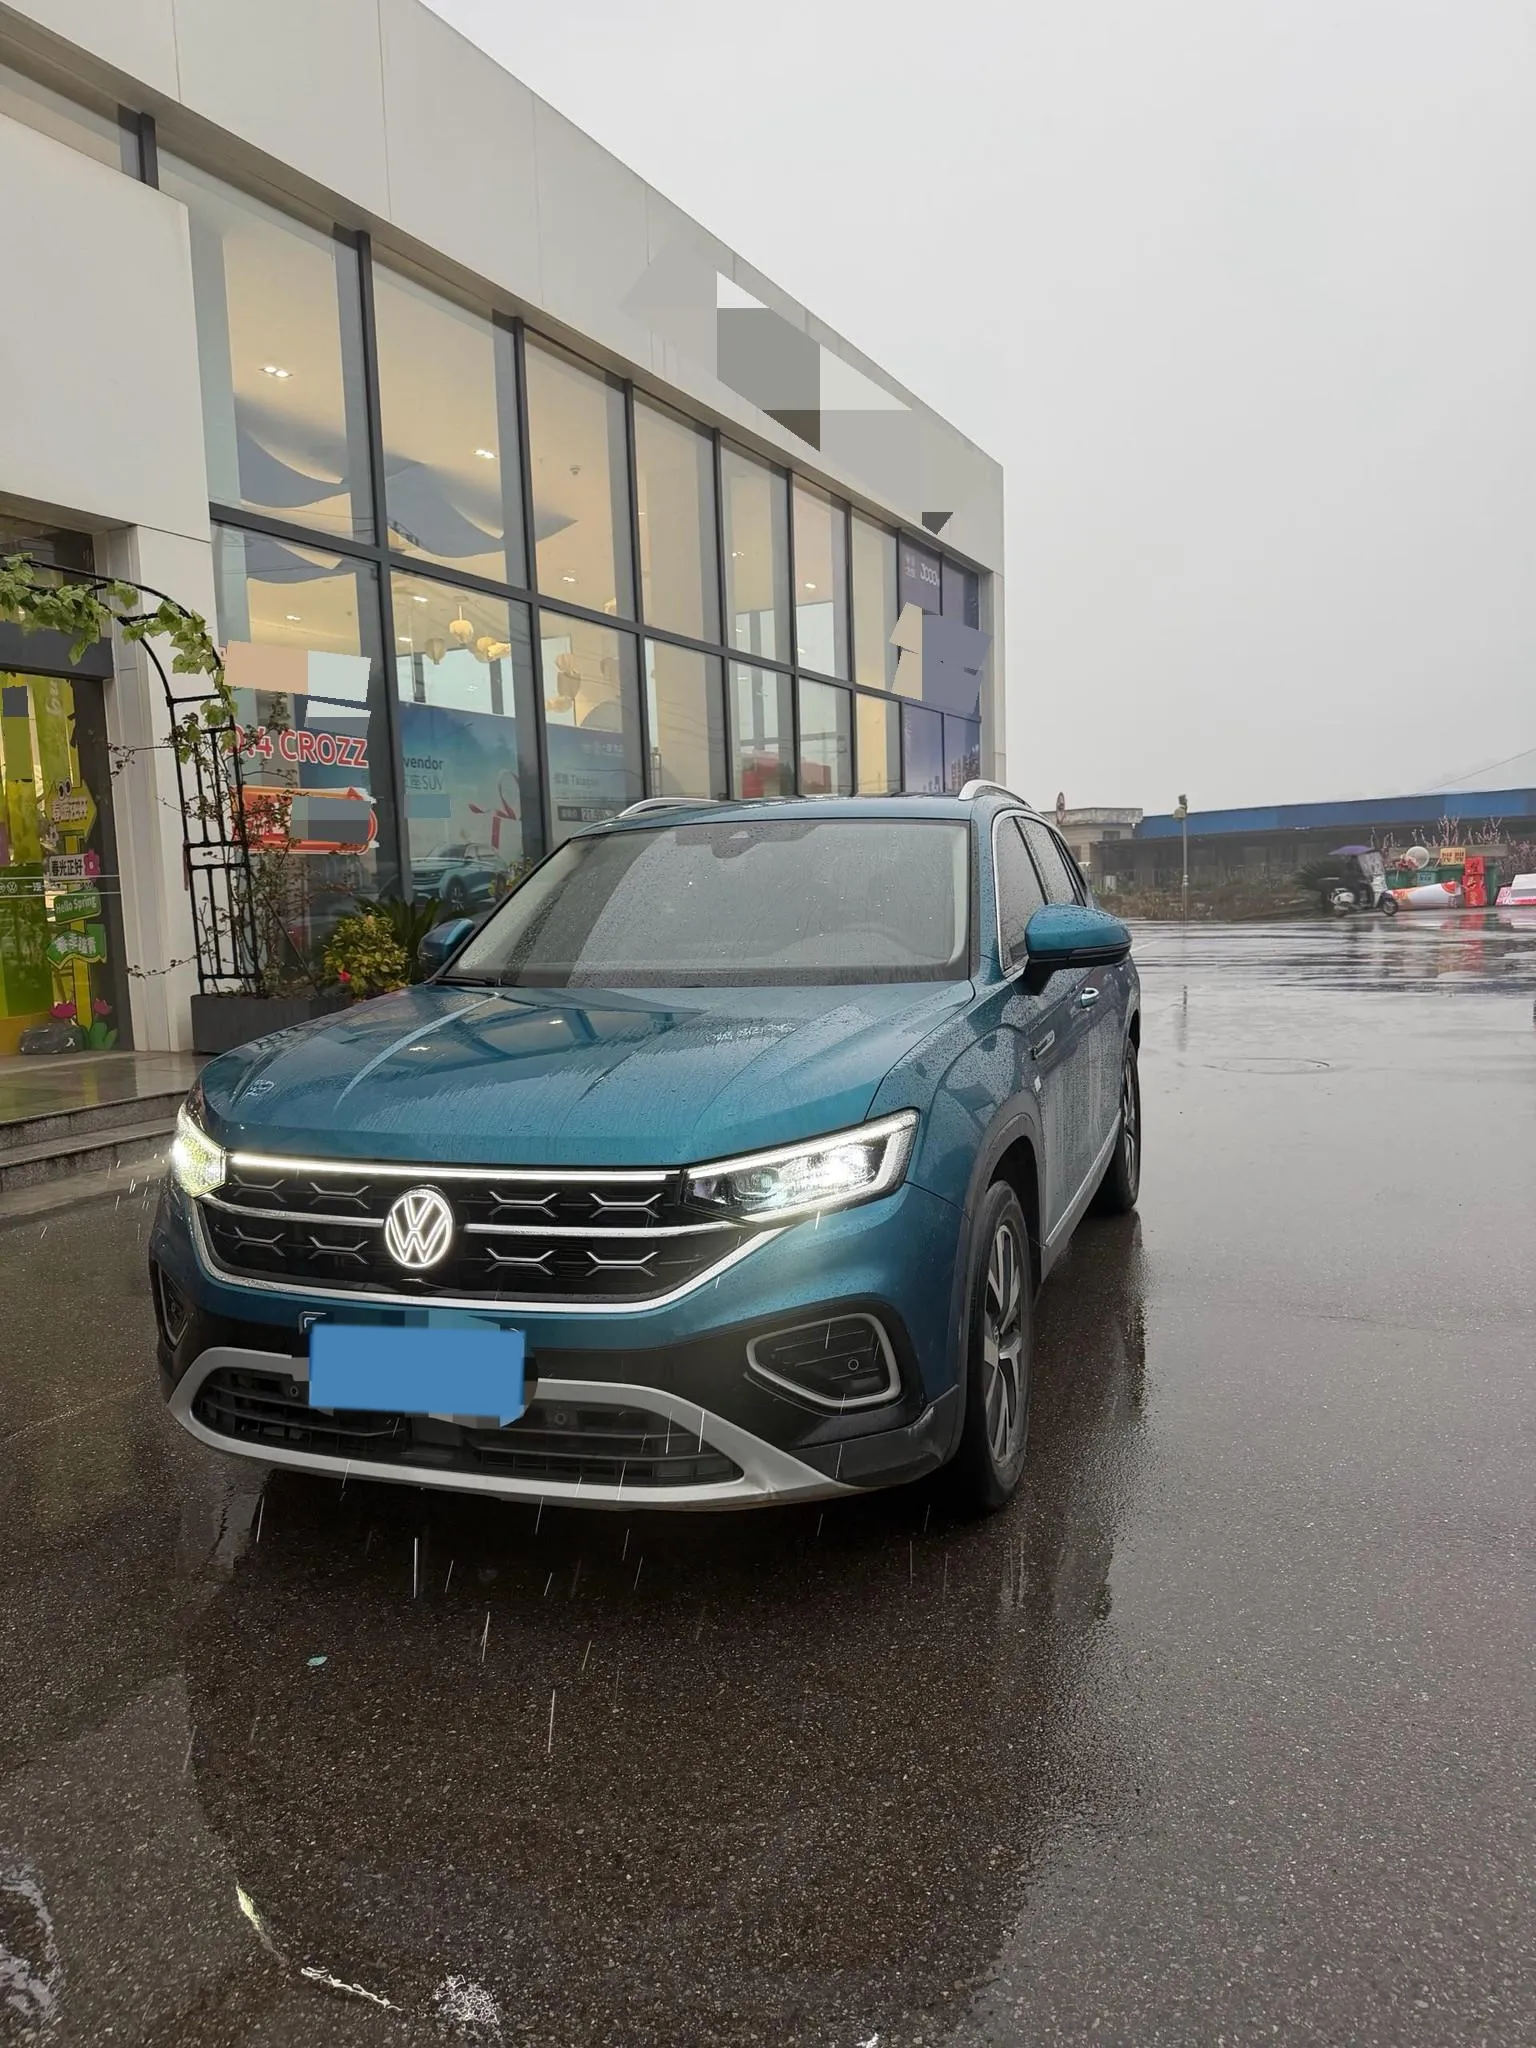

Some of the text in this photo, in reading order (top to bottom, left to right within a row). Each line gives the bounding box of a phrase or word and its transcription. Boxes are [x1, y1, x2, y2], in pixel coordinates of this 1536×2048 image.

[279, 729, 369, 768] CROZZ
[403, 755, 444, 770] vendor
[404, 774, 443, 790] 座SUV
[51, 858, 84, 877] 春光正好
[55, 895, 97, 914] Hello Spring
